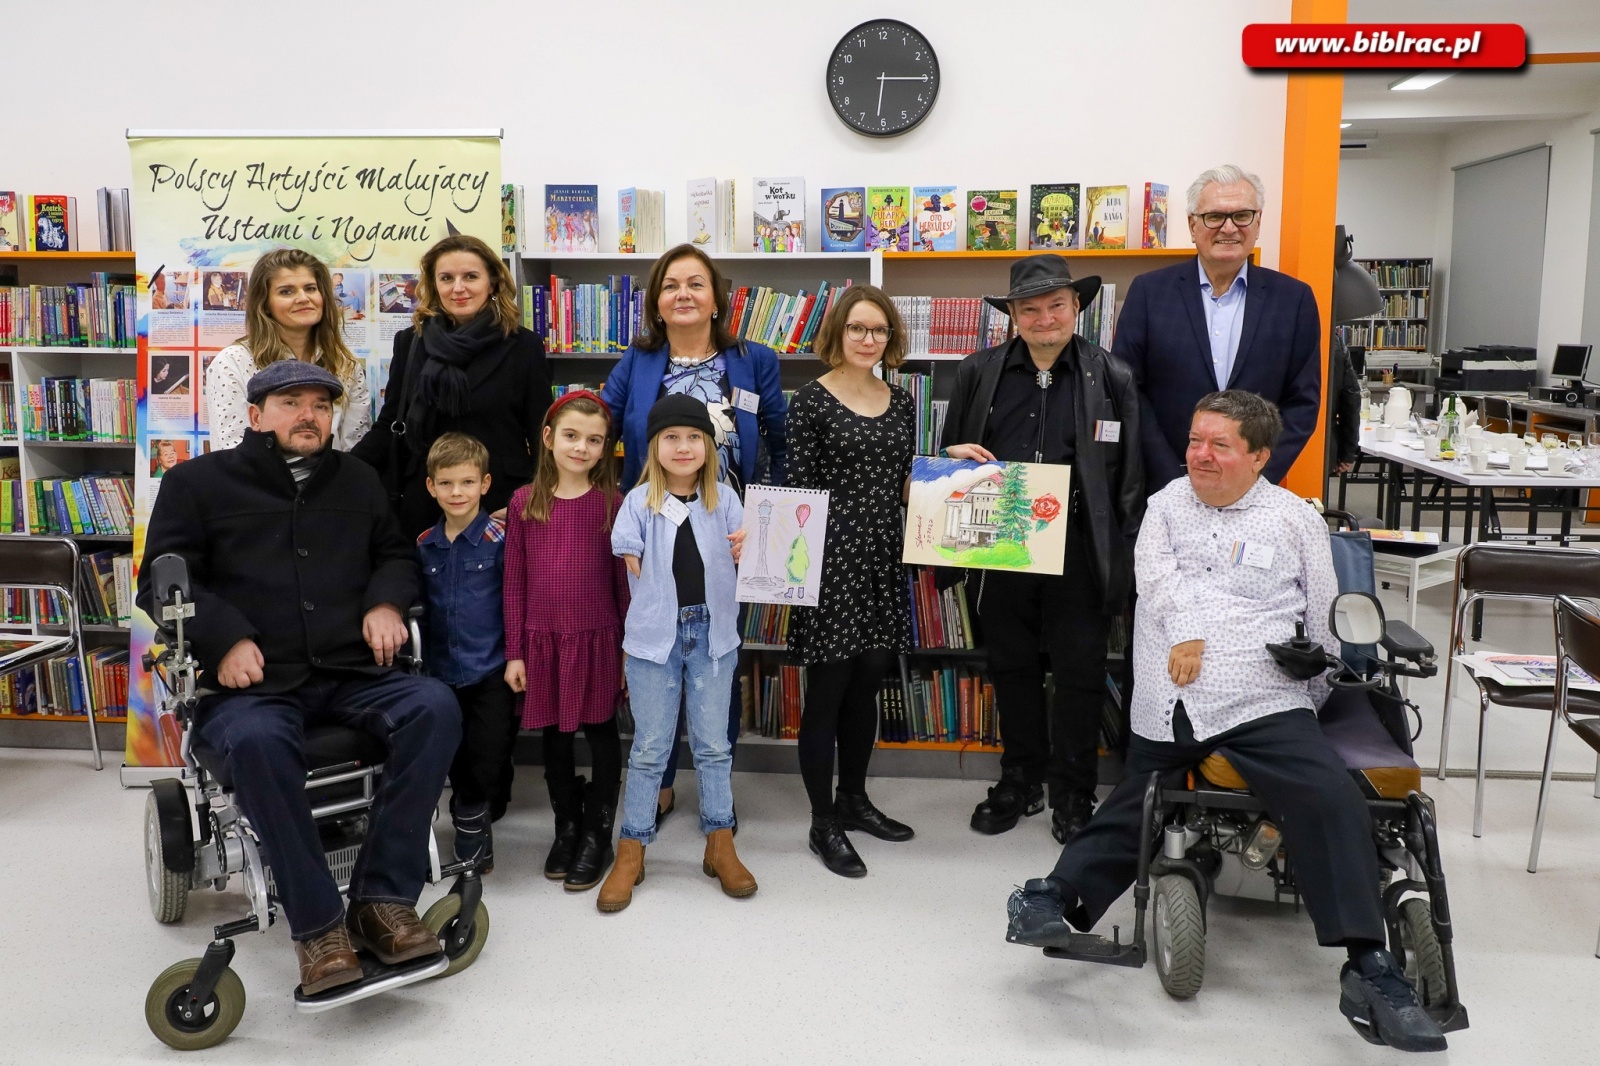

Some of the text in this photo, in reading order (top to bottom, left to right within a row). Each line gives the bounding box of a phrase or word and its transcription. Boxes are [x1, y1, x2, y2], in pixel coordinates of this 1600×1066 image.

[844, 55, 852, 63] 10
[916, 52, 920, 60] 2
[922, 74, 928, 82] 3
[860, 112, 865, 121] 7
[902, 111, 906, 119] 5
[881, 118, 886, 127] 6
[149, 158, 237, 211] Polscy
[246, 162, 349, 212] Artyści
[1107, 198, 1121, 206] KUBA
[1104, 212, 1122, 220] KANGA
[920, 220, 952, 231] HERKULES!
[202, 214, 432, 262] Ustami i Nogami
